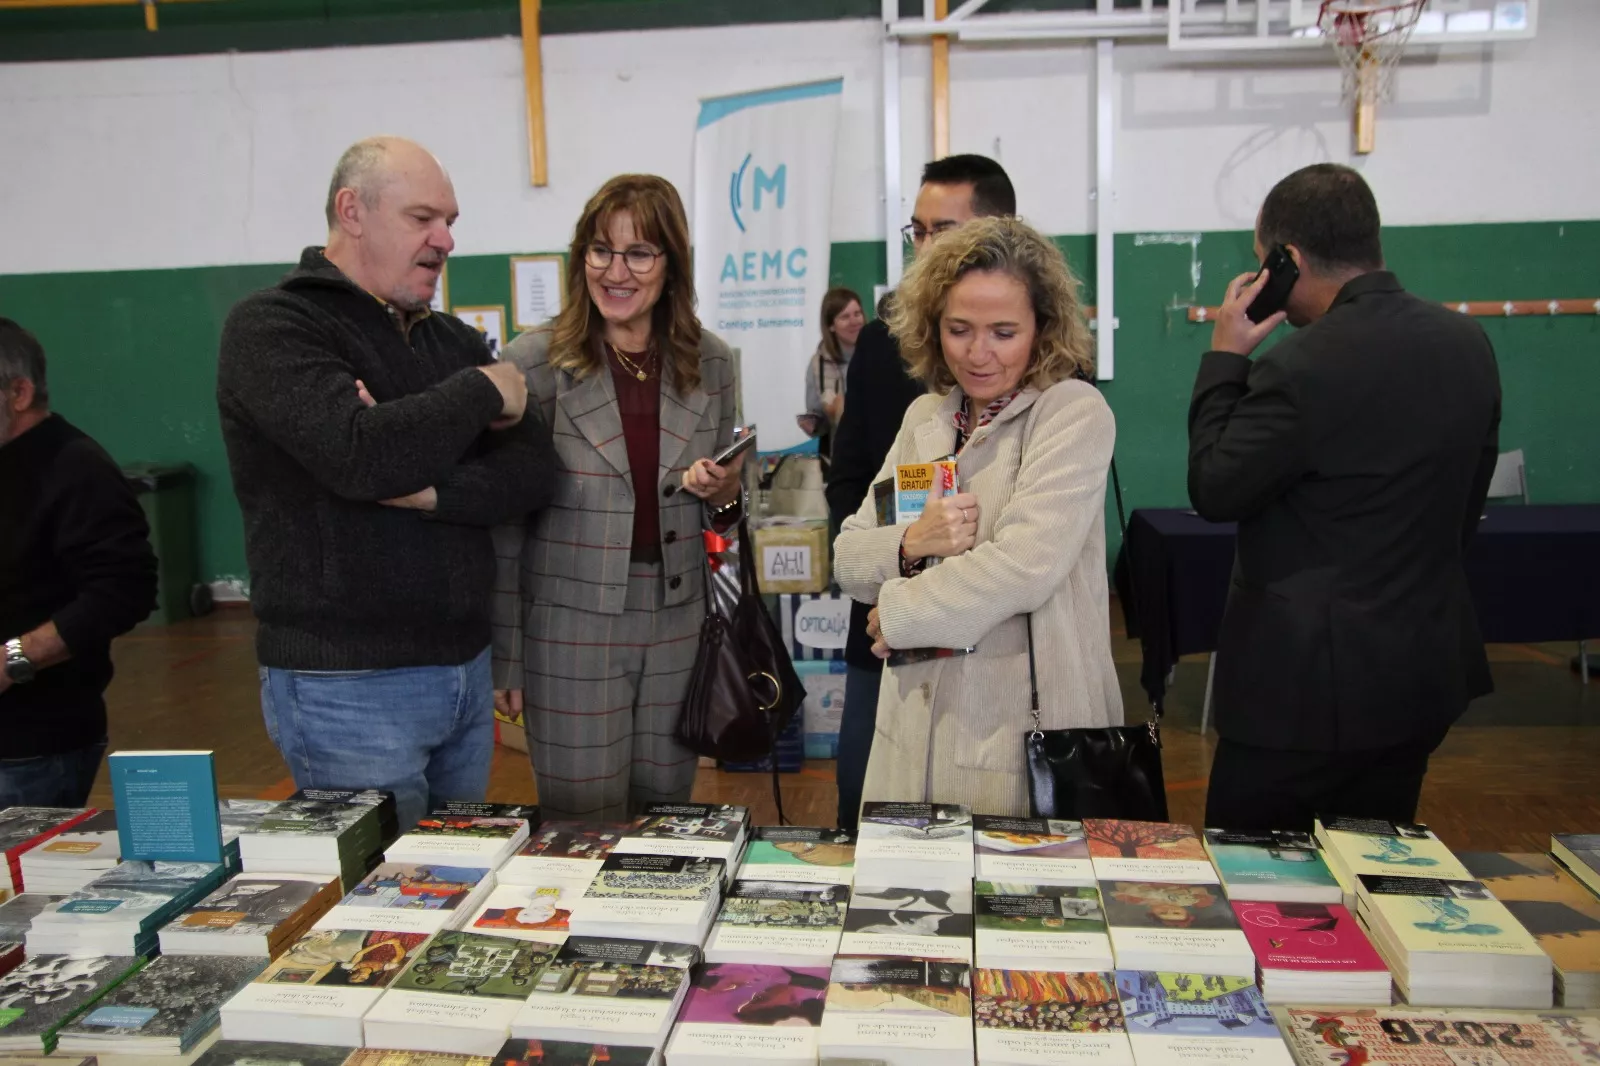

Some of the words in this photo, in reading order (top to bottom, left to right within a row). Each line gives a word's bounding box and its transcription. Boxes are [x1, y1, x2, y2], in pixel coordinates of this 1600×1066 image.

[720, 247, 808, 283] AEMC
[719, 319, 754, 331] Contigo
[757, 317, 804, 328] Sumamos
[900, 468, 926, 478] TALLER
[902, 1031, 936, 1040] Albert
[1378, 1019, 1534, 1049] 2026
[748, 1035, 804, 1043] Muchachas
[996, 1038, 1021, 1046] odio
[1042, 1041, 1069, 1049] amor
[1082, 1042, 1111, 1050] Entre
